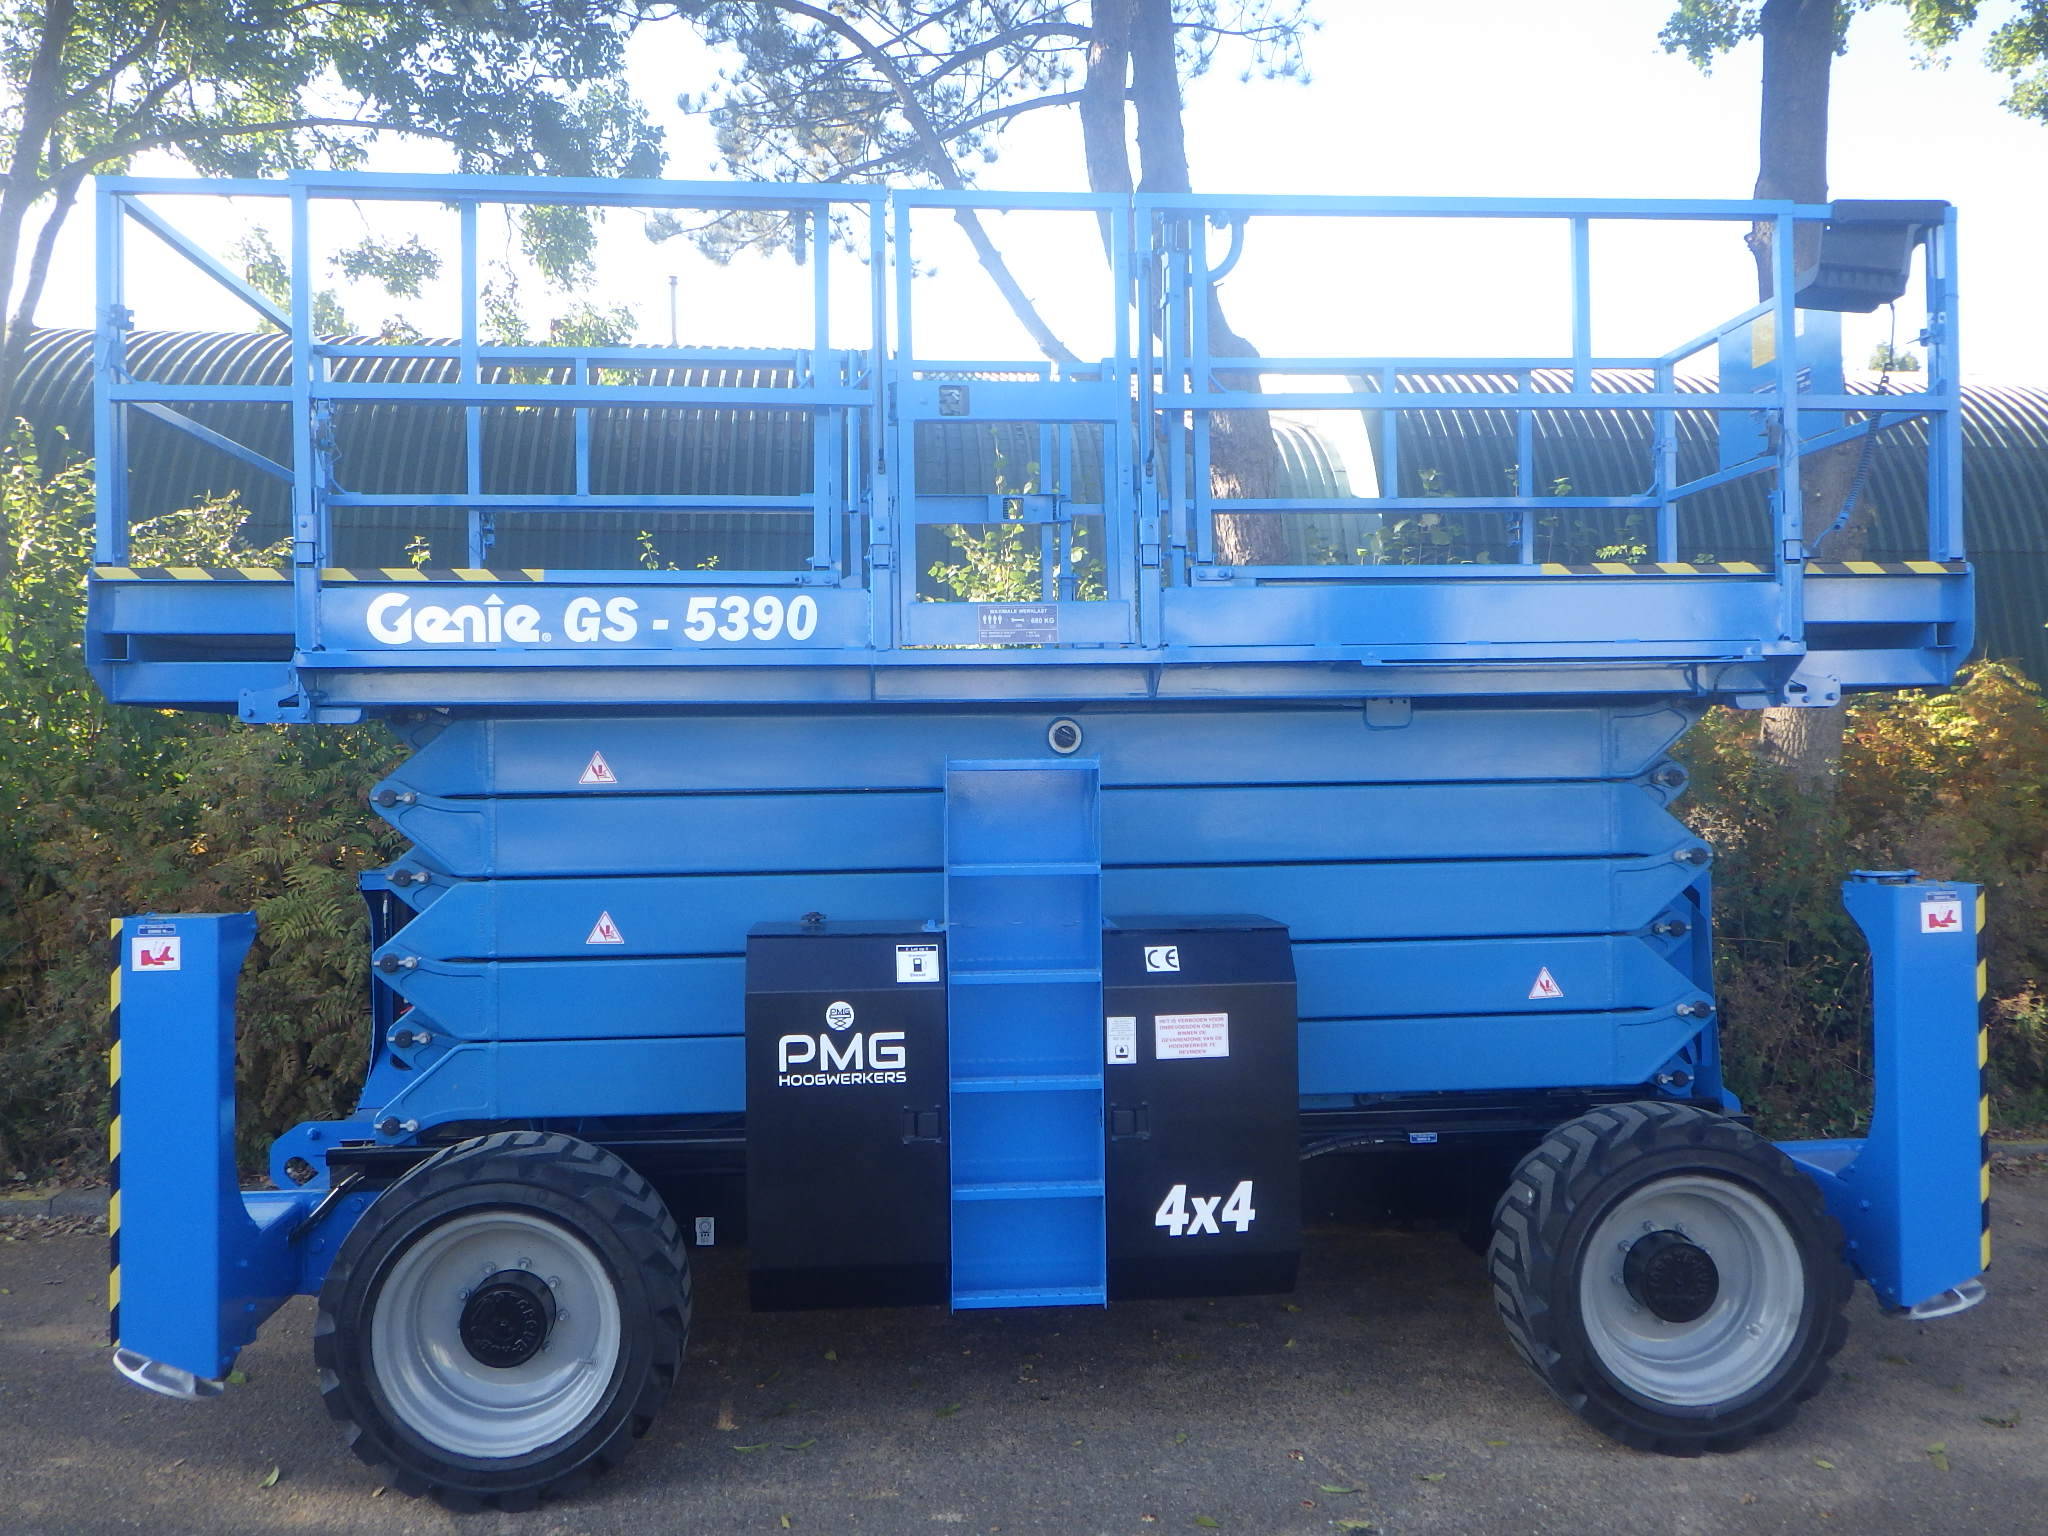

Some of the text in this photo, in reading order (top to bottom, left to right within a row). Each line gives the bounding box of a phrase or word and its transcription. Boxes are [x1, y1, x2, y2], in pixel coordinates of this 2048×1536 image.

[366, 592, 541, 645] Genie
[564, 596, 639, 643] GS
[683, 595, 818, 642] 5390
[1147, 948, 1178, 968] CE
[829, 1007, 851, 1015] PMG
[779, 1032, 906, 1072] PMG
[779, 1072, 907, 1086] HOOGWERKERS
[1155, 1181, 1256, 1236] 4x4
